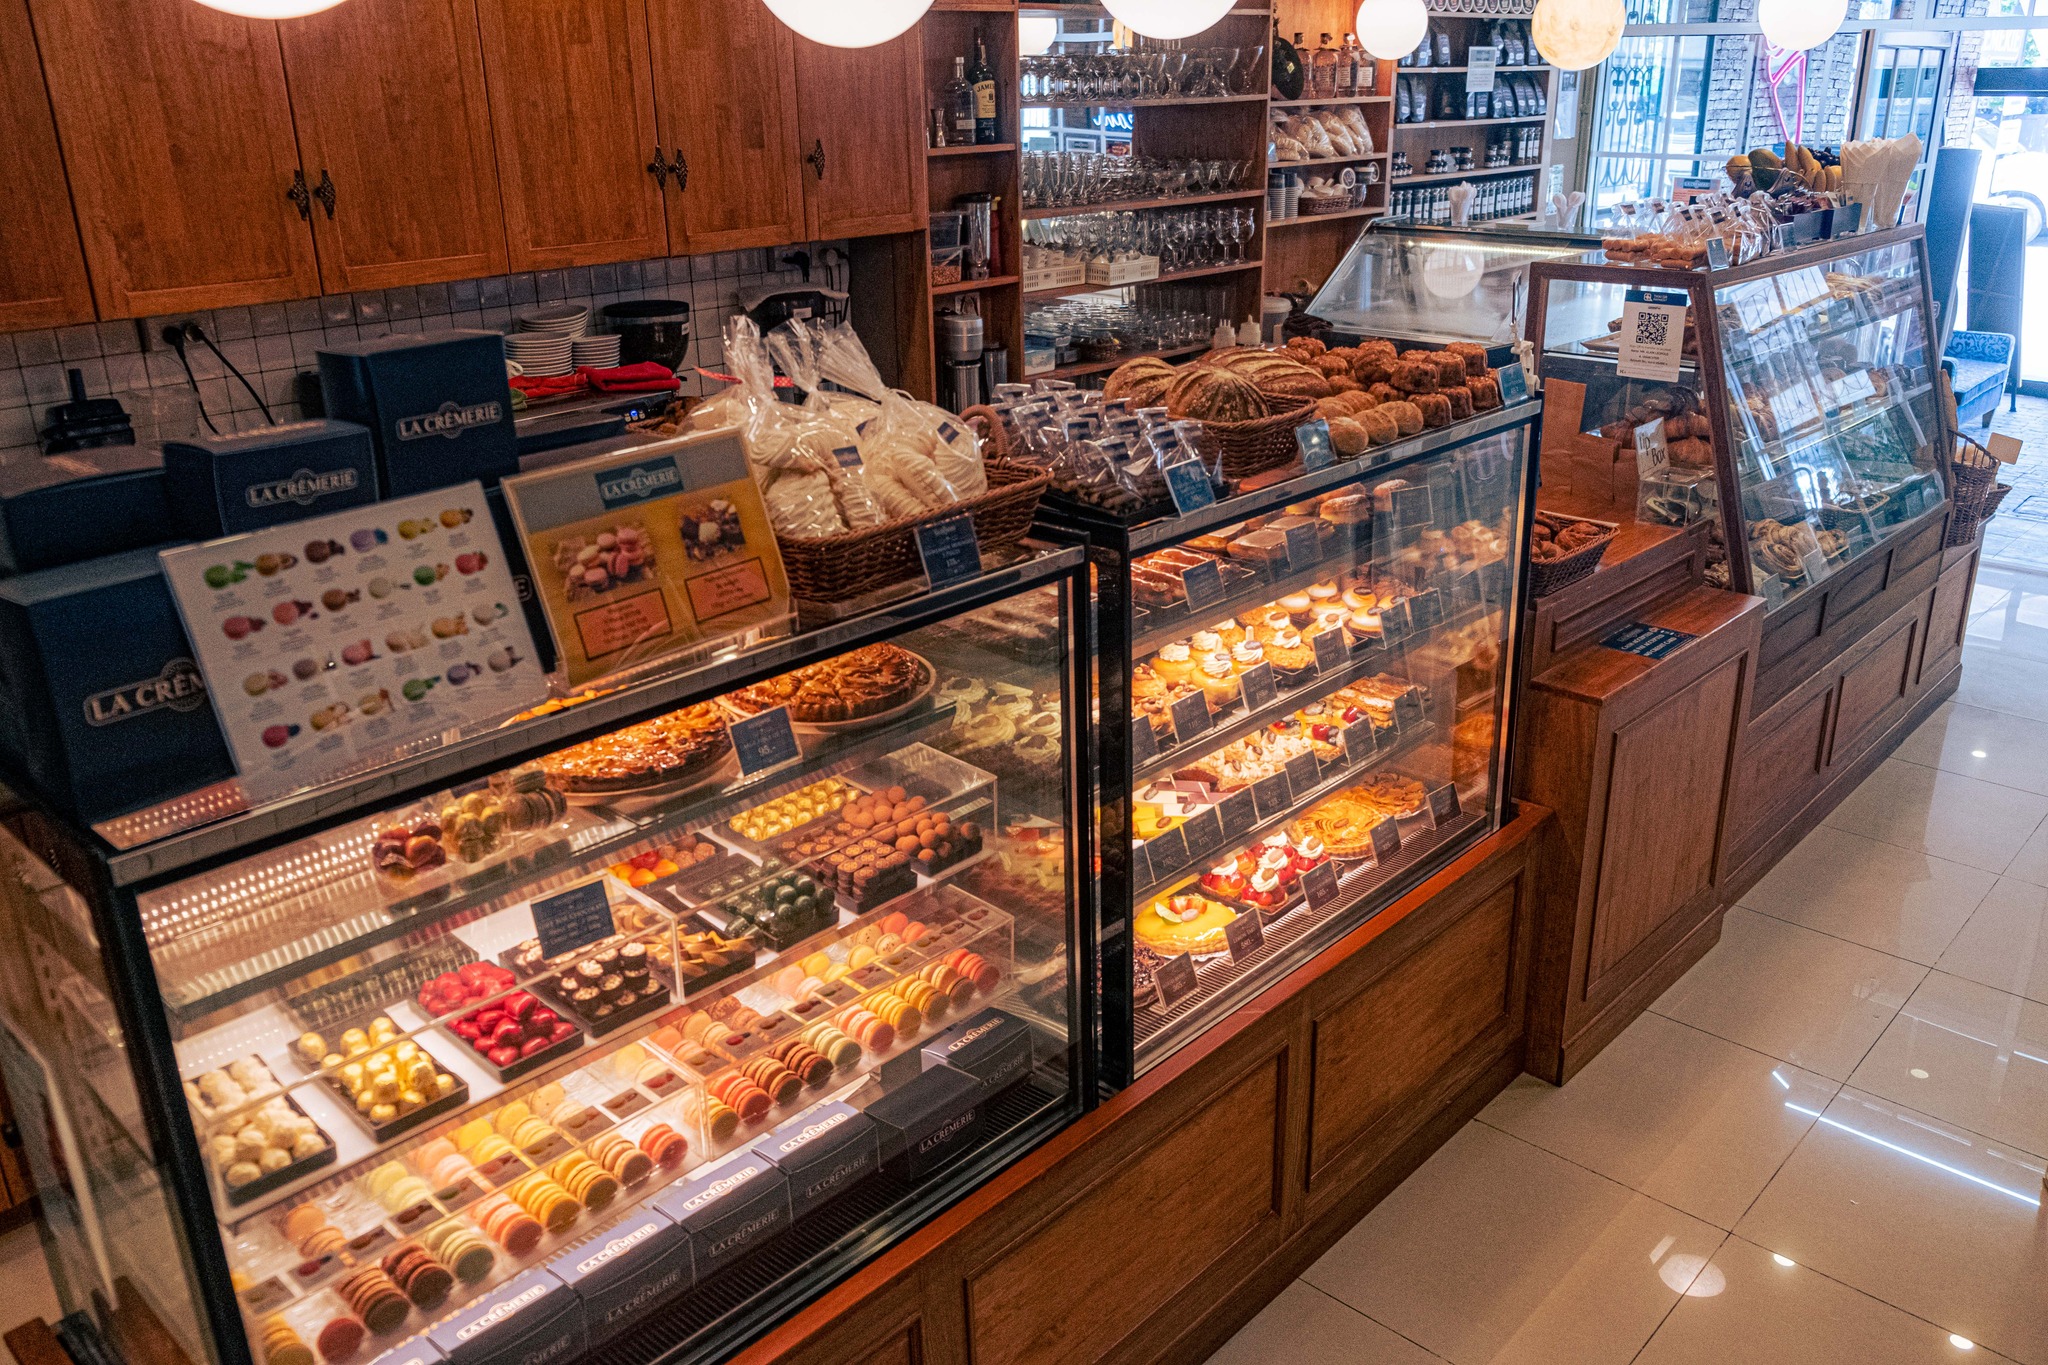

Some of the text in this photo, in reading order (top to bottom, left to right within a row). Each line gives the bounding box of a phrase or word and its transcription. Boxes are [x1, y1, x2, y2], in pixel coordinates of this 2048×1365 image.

[400, 419, 421, 437] LA
[1652, 447, 1665, 466] Box
[250, 487, 273, 504] LA
[603, 483, 620, 499] LA
[91, 693, 132, 721] LA
[950, 1040, 964, 1050] LA
[781, 1139, 799, 1151] LA
[921, 1139, 933, 1151] LA
[809, 1184, 821, 1197] LA
[685, 1197, 703, 1210] LA
[711, 1241, 726, 1255] LA
[579, 1259, 598, 1272] LA
[607, 1307, 623, 1321] LA
[458, 1324, 480, 1338] LA
